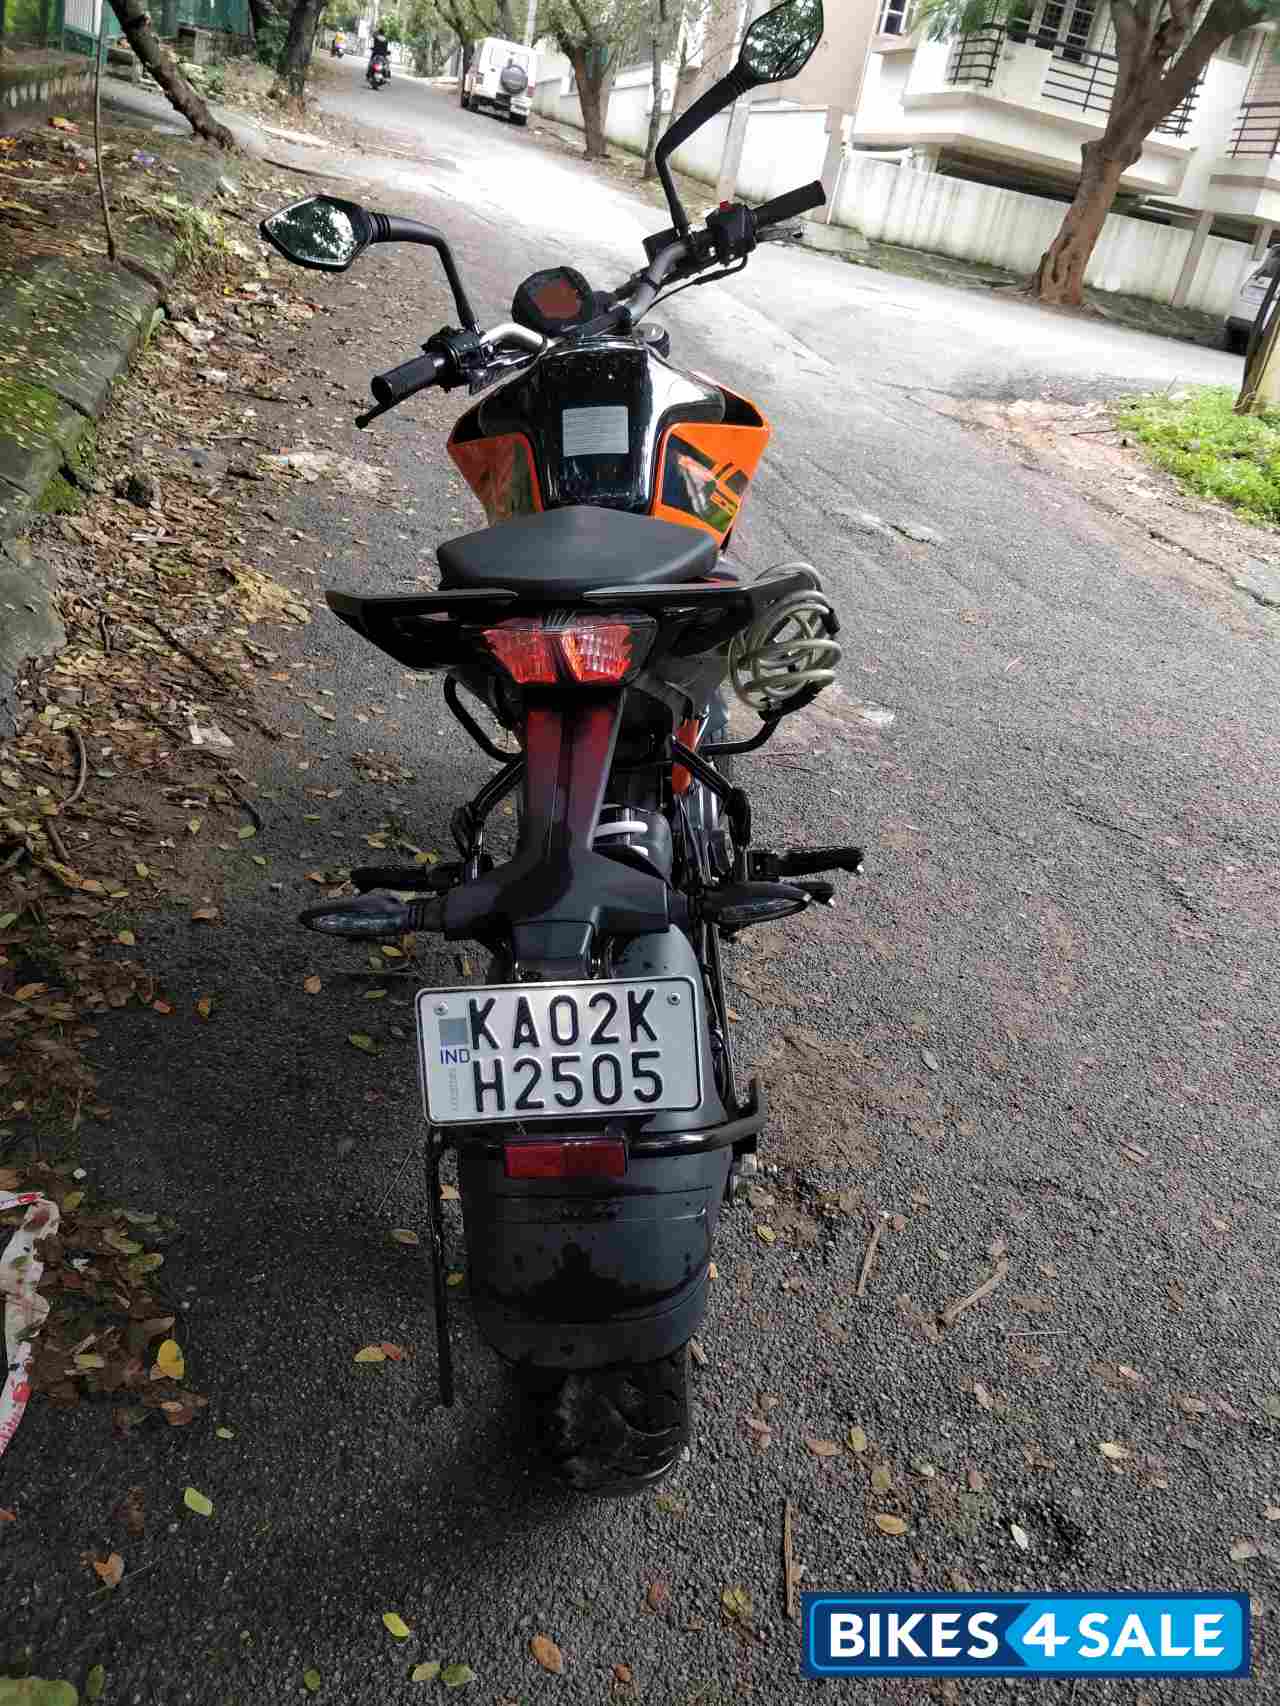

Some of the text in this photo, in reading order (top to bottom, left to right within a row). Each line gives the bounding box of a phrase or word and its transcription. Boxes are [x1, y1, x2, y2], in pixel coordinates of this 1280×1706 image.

[469, 988, 658, 1050] KA02K
[440, 1048, 471, 1064] IND
[473, 1050, 664, 1112] H2505
